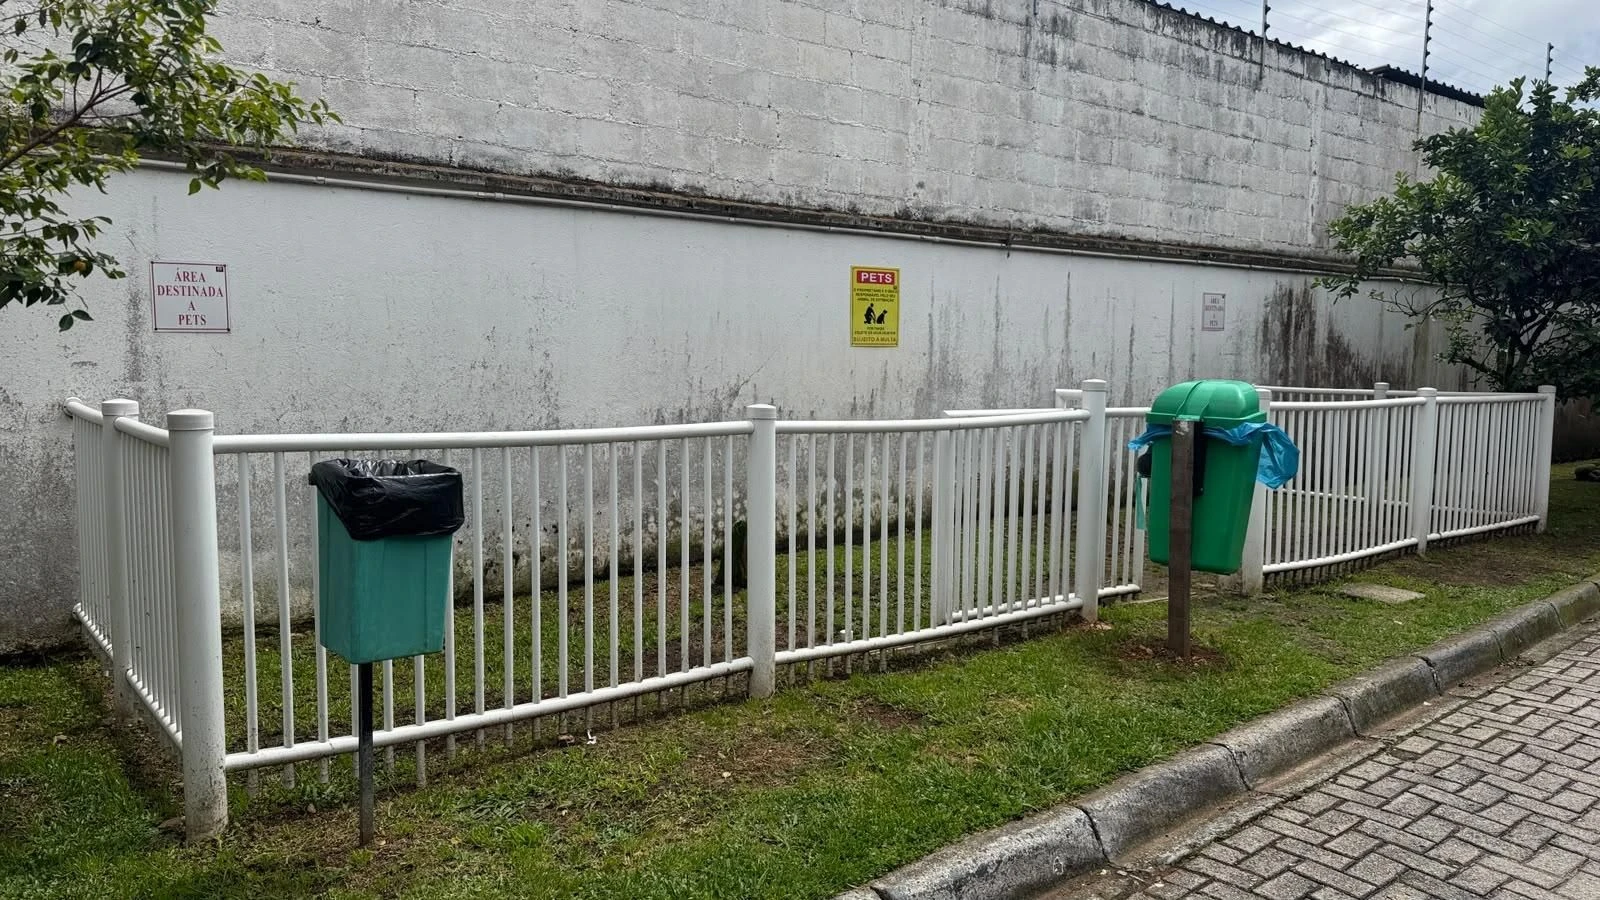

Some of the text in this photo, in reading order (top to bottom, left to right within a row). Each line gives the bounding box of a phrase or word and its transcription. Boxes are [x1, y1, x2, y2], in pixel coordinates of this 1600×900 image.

[174, 267, 206, 282] ÁREA
[861, 272, 893, 283] PETS
[157, 285, 224, 297] DESTINADA
[188, 300, 196, 311] A
[178, 314, 207, 326] PETS
